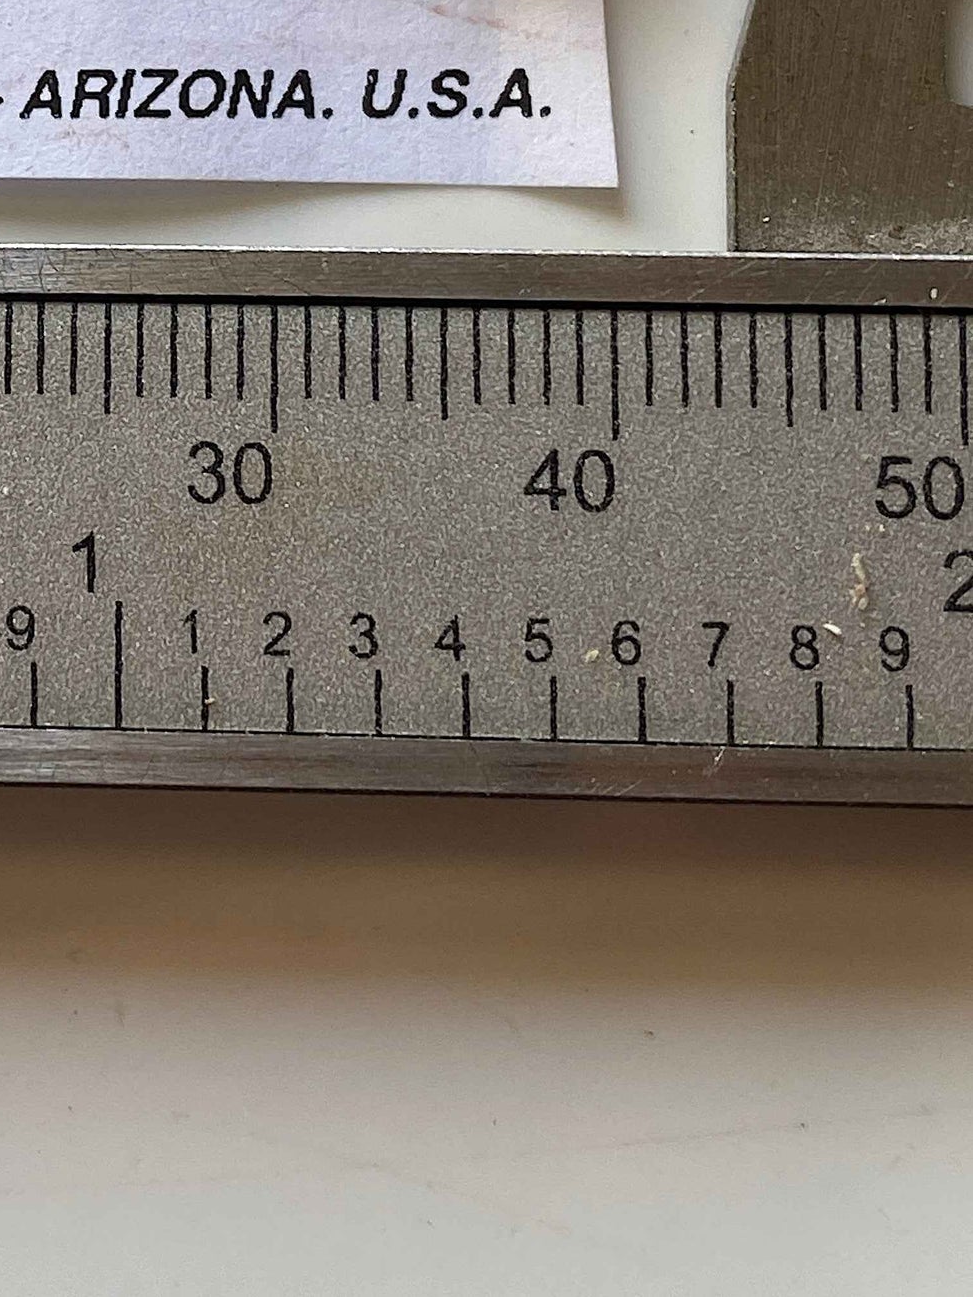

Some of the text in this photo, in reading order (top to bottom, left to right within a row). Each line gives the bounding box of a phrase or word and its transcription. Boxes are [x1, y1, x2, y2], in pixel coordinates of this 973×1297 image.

[19, 68, 334, 120] ARIZONA.
[361, 67, 551, 120] U.S.A.
[187, 440, 273, 505] 30
[523, 448, 616, 513] 40
[875, 455, 965, 521] 50
[72, 531, 97, 594] 1
[5, 605, 36, 651] 9
[184, 609, 198, 655] 1
[262, 611, 292, 657] 2
[348, 611, 379, 660] 3
[434, 614, 467, 662] 4
[524, 617, 554, 663] 5
[610, 620, 642, 666] 6
[701, 621, 730, 668] 7
[789, 625, 820, 671] 8
[878, 625, 910, 673] 9
